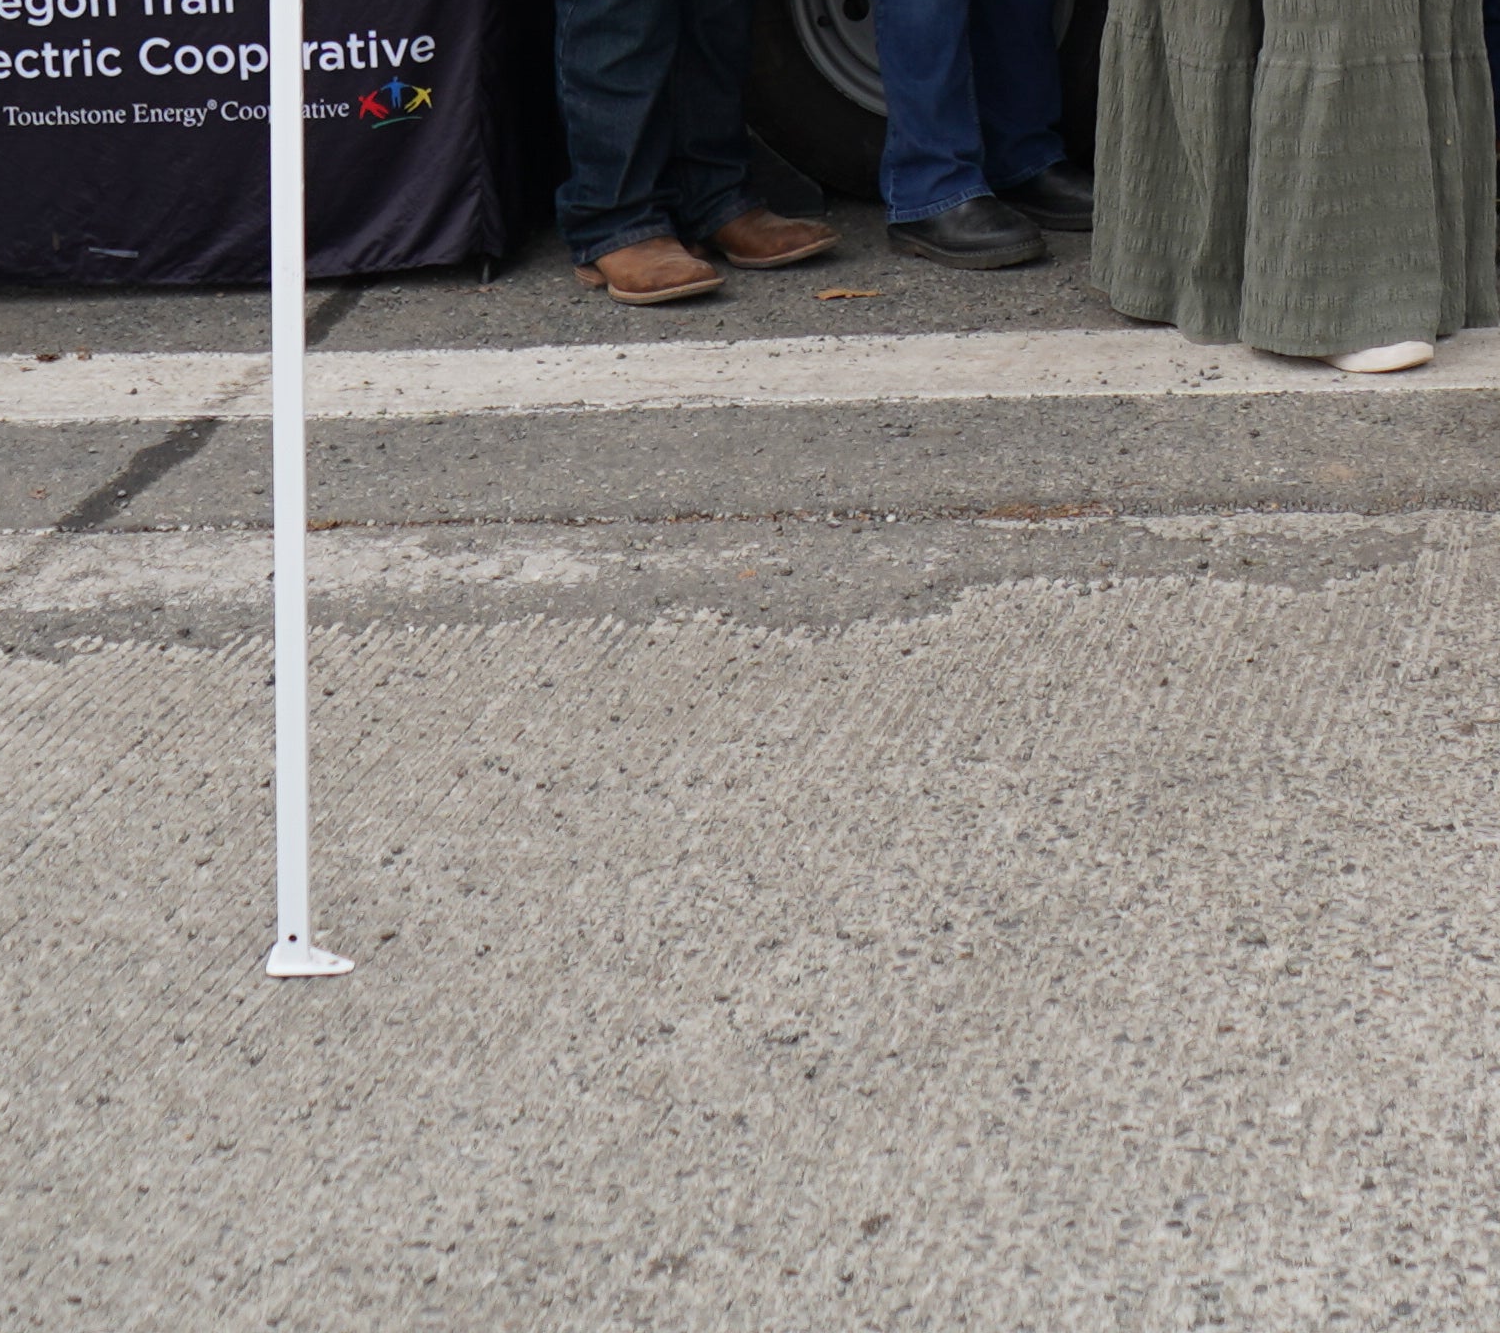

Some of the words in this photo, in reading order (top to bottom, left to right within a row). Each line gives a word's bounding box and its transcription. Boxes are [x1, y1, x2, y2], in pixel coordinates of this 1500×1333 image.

[137, 29, 437, 81] Cooprative
[2, 102, 127, 127] Touchstone
[219, 97, 351, 125] Cooative
